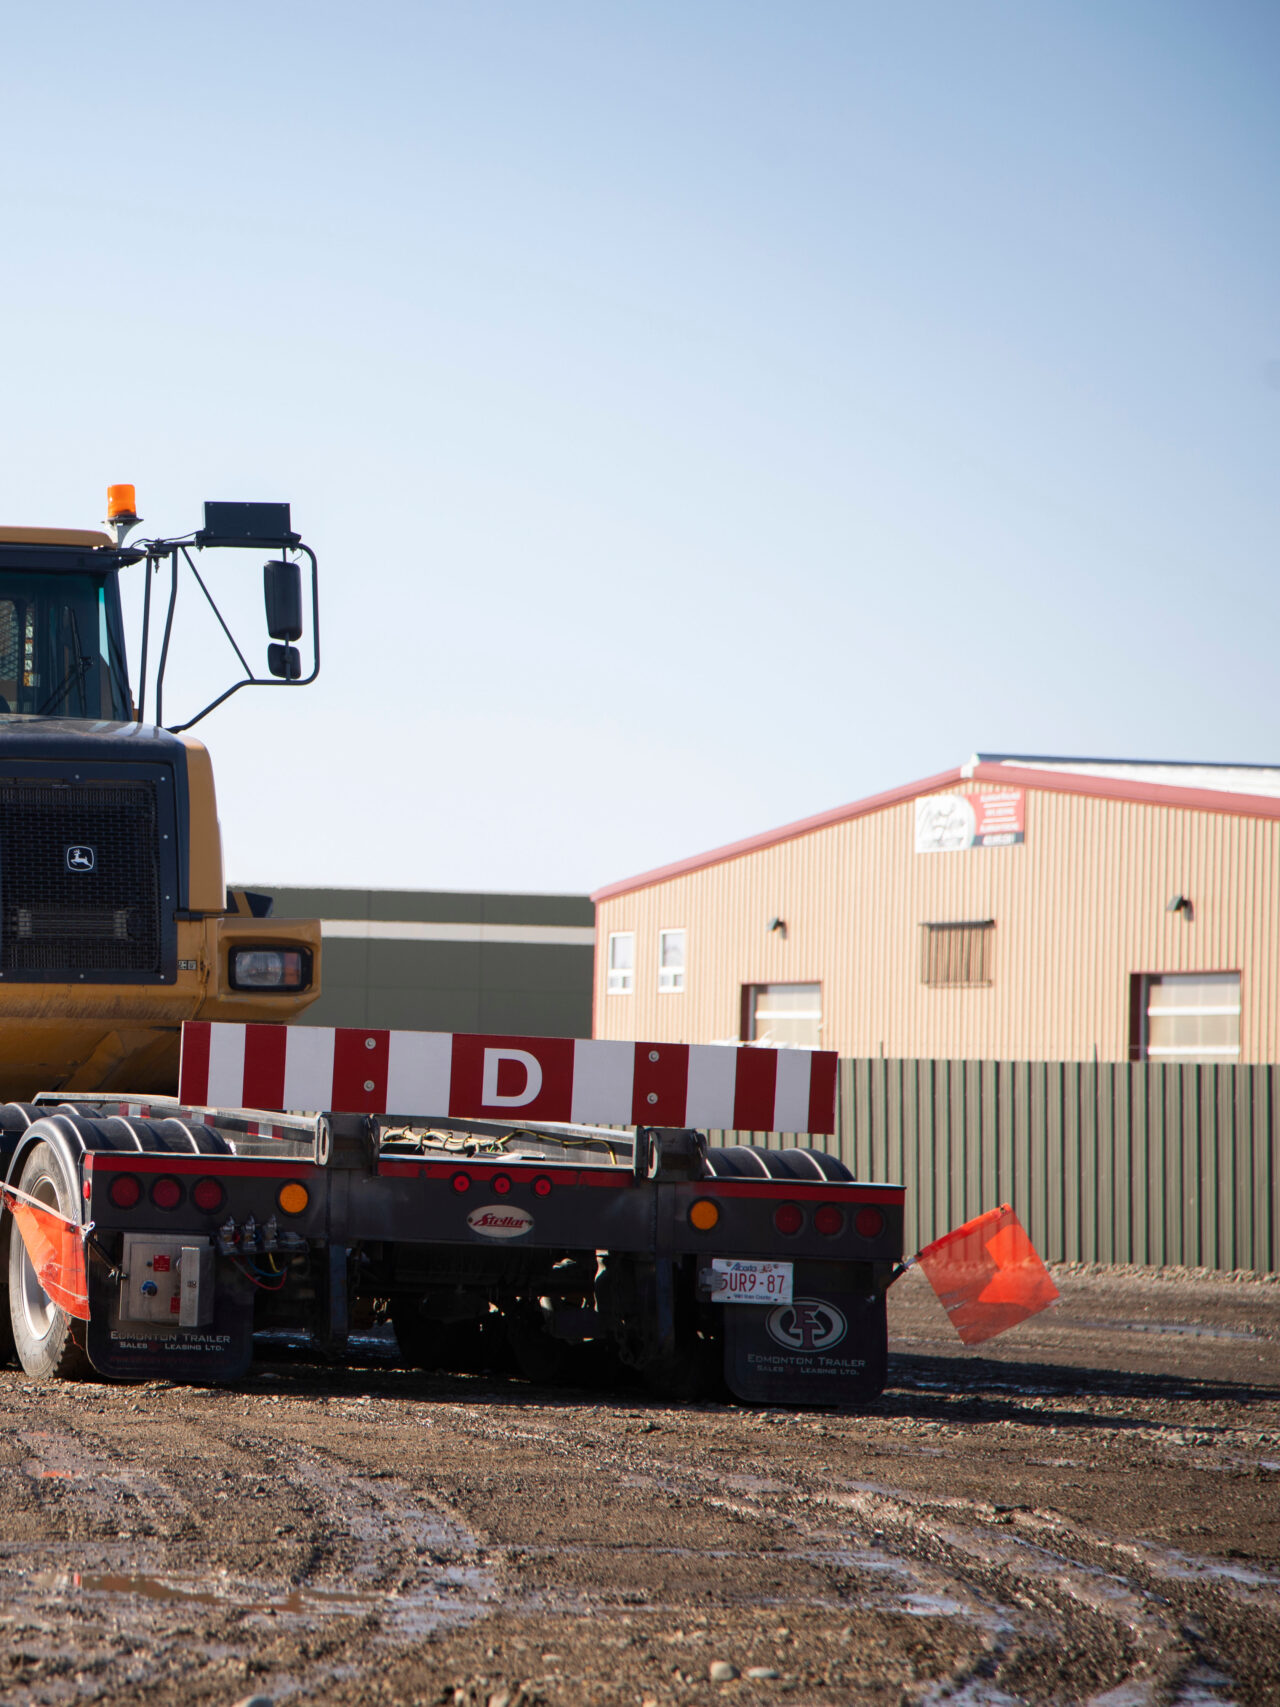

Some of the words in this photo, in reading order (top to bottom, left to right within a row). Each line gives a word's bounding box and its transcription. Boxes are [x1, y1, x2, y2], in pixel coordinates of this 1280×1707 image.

[481, 1047, 543, 1108] D
[472, 1212, 529, 1228] Stellar
[183, 1333, 231, 1344] TRAILER
